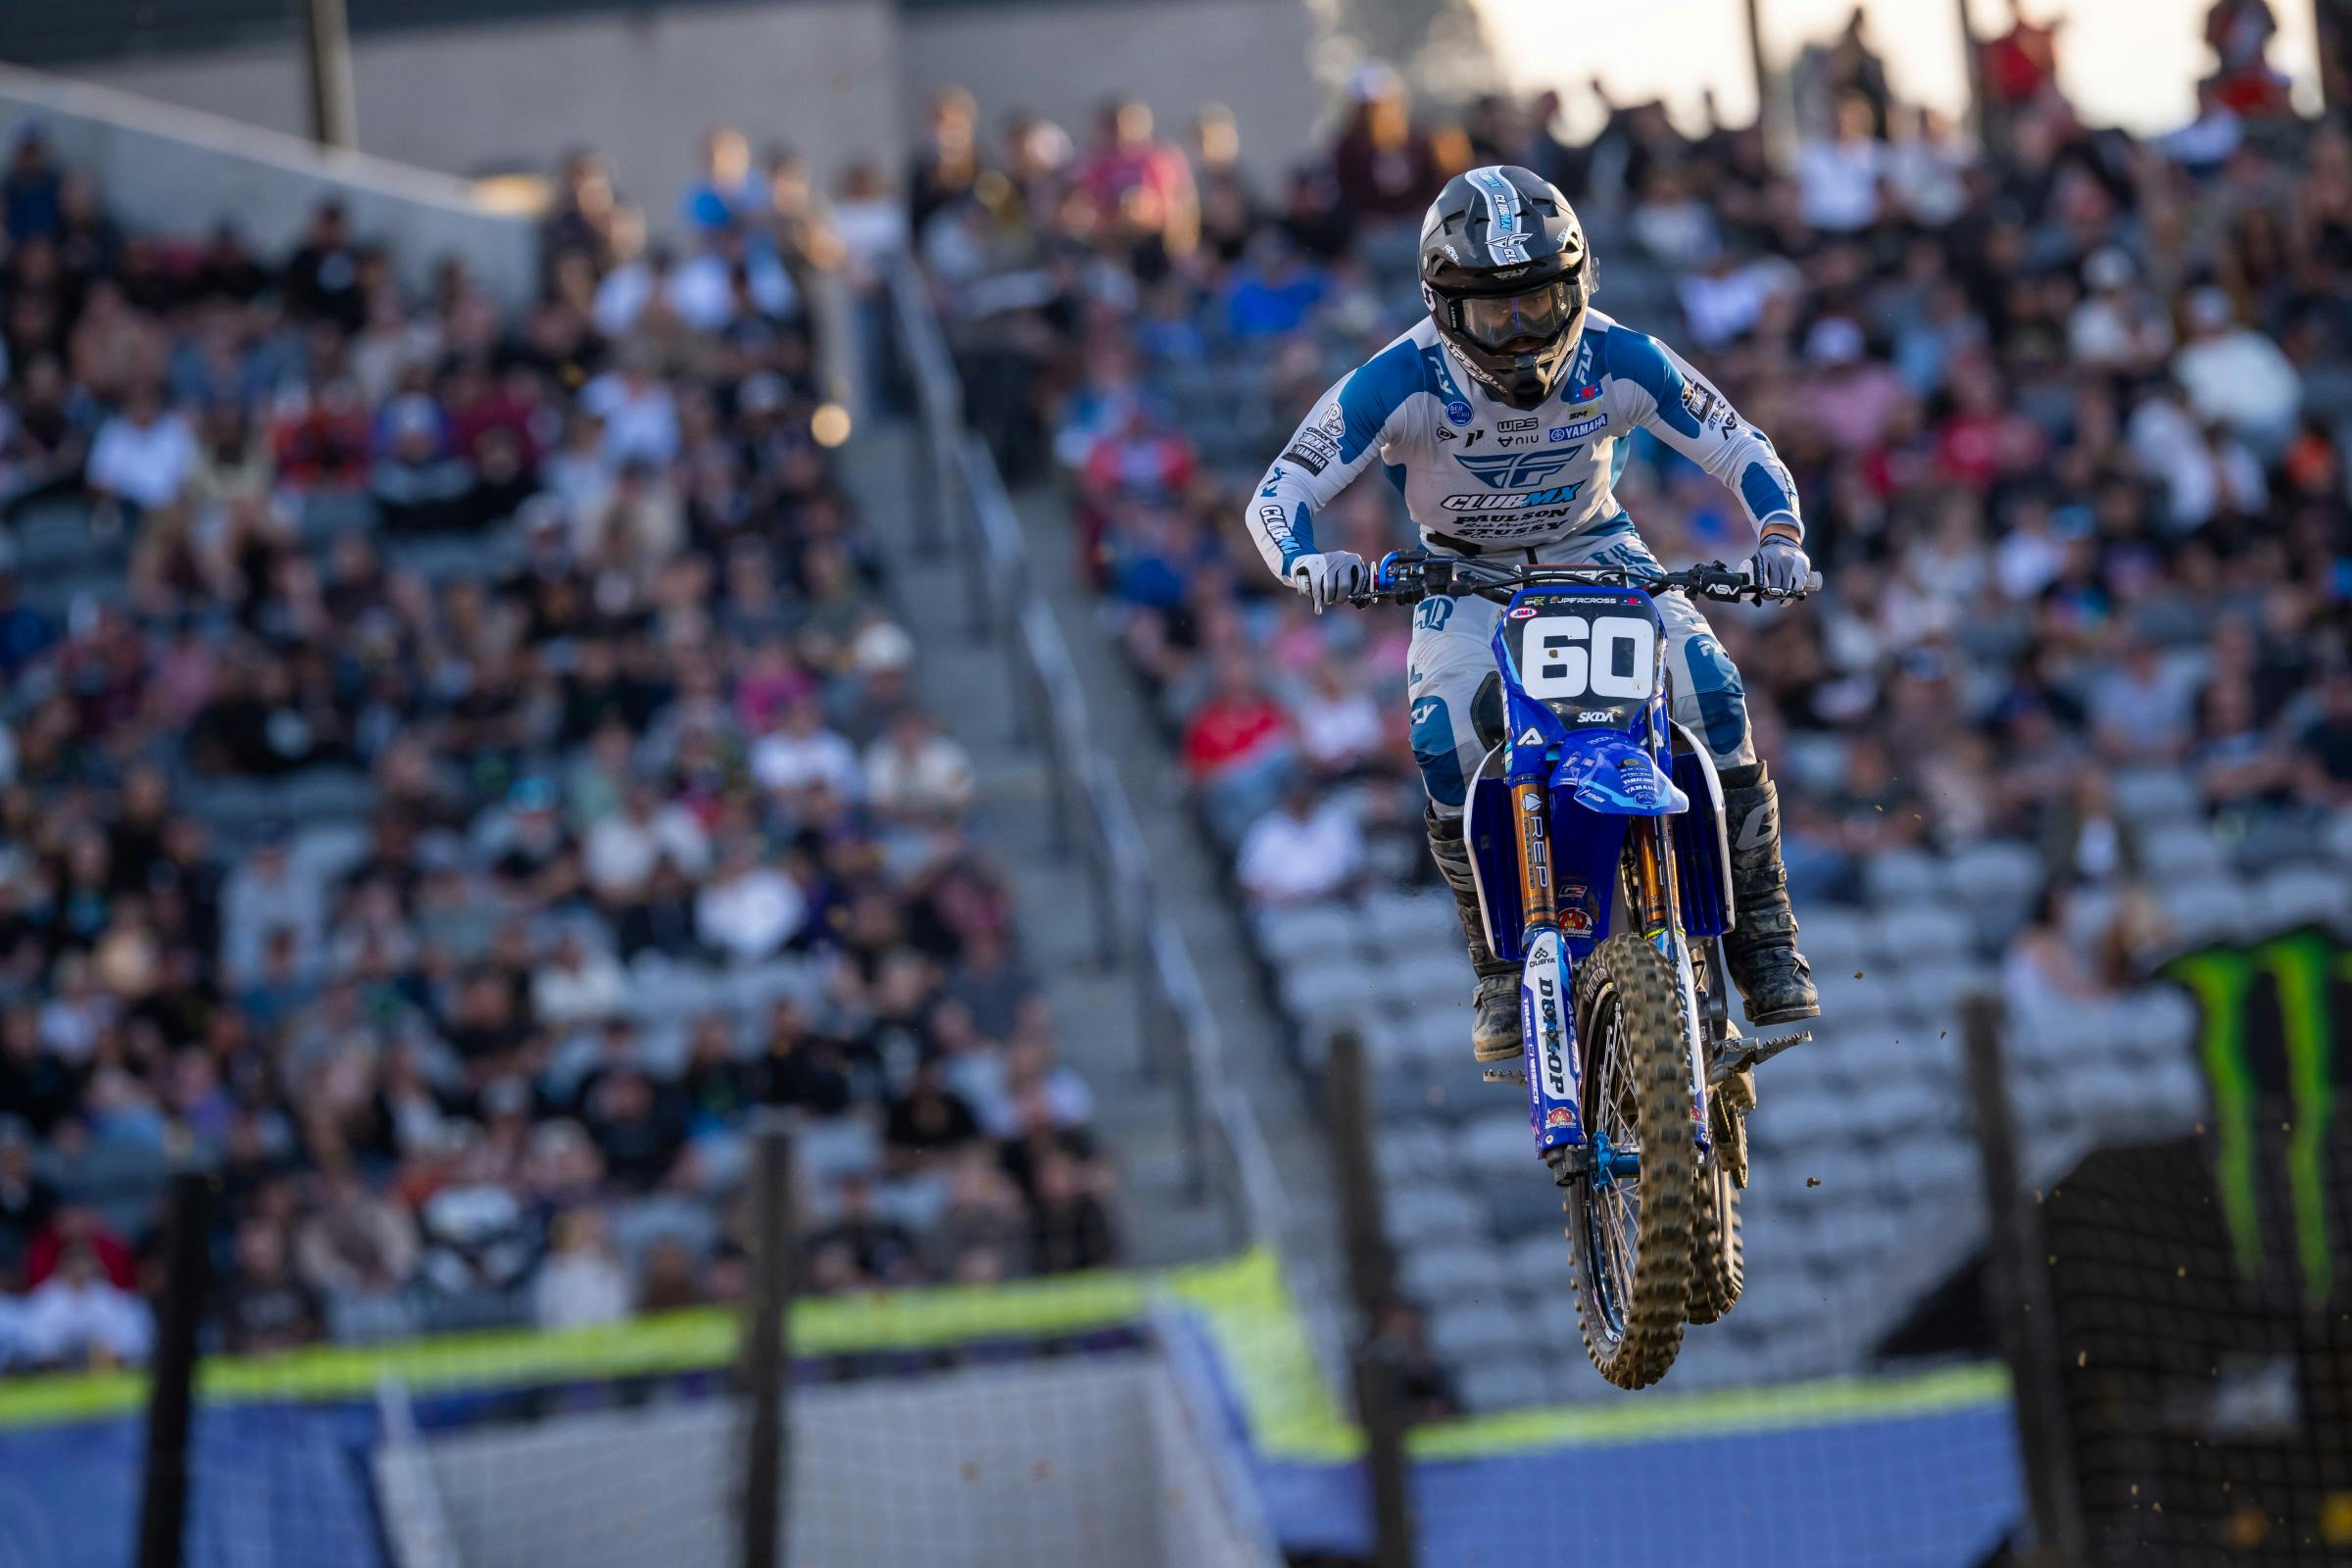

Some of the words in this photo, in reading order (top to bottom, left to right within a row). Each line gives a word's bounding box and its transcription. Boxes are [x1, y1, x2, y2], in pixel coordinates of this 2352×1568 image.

[1494, 194, 1513, 231] CLUBMX
[1575, 340, 1594, 386] FLY
[1497, 417, 1538, 433] WPS
[1567, 416, 1607, 439] YAMAHA
[1294, 445, 1327, 470] YAMAHA
[1441, 478, 1588, 512] CLUBMX
[1452, 506, 1571, 524] PAULSON
[1259, 505, 1302, 556] CLUBM
[1453, 519, 1569, 537] STUSSY
[1705, 583, 1740, 596] ASV
[1764, 587, 1791, 597] ASV
[1521, 615, 1655, 701] 60
[1576, 711, 1615, 723] SKDA
[1530, 815, 1548, 889] REP
[1529, 957, 1556, 968] DUBYA
